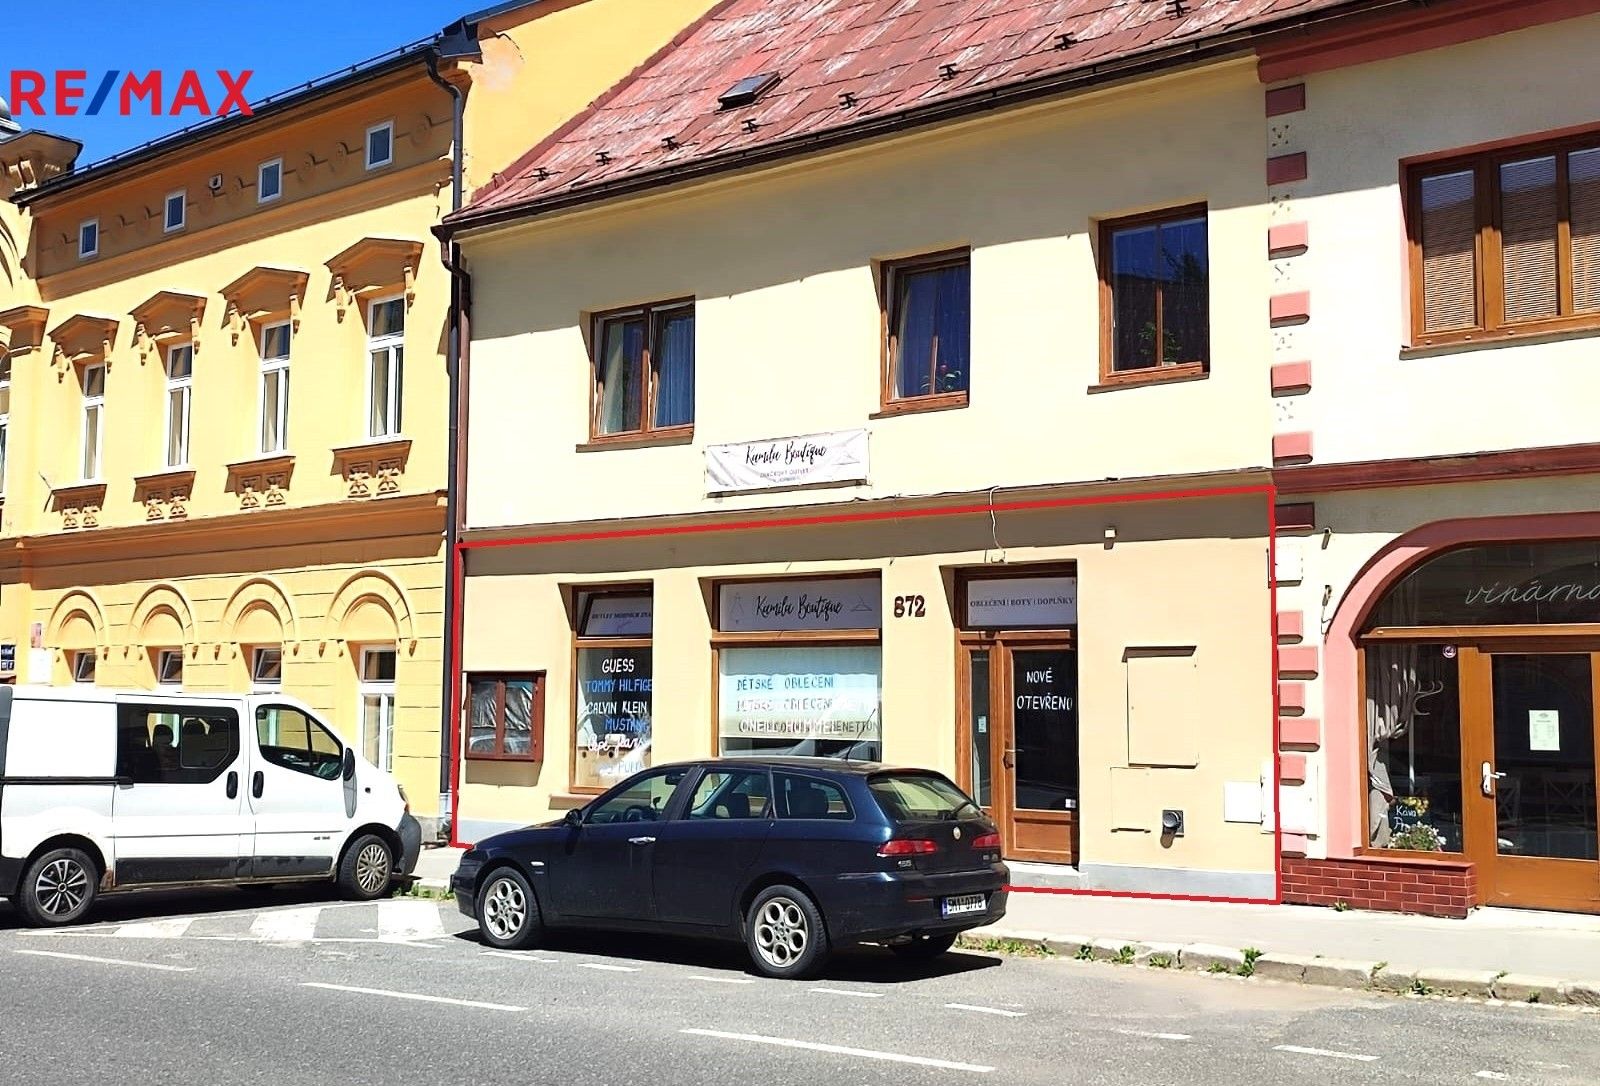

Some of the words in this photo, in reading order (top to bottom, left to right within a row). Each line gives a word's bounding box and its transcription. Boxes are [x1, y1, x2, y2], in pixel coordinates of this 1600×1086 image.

[798, 593, 843, 621] Boutique
[894, 595, 926, 617] 872
[602, 658, 635, 673] GUESS
[585, 680, 616, 693] TOMMY
[587, 702, 618, 715] CALVIN
[622, 700, 648, 714] KLEIN
